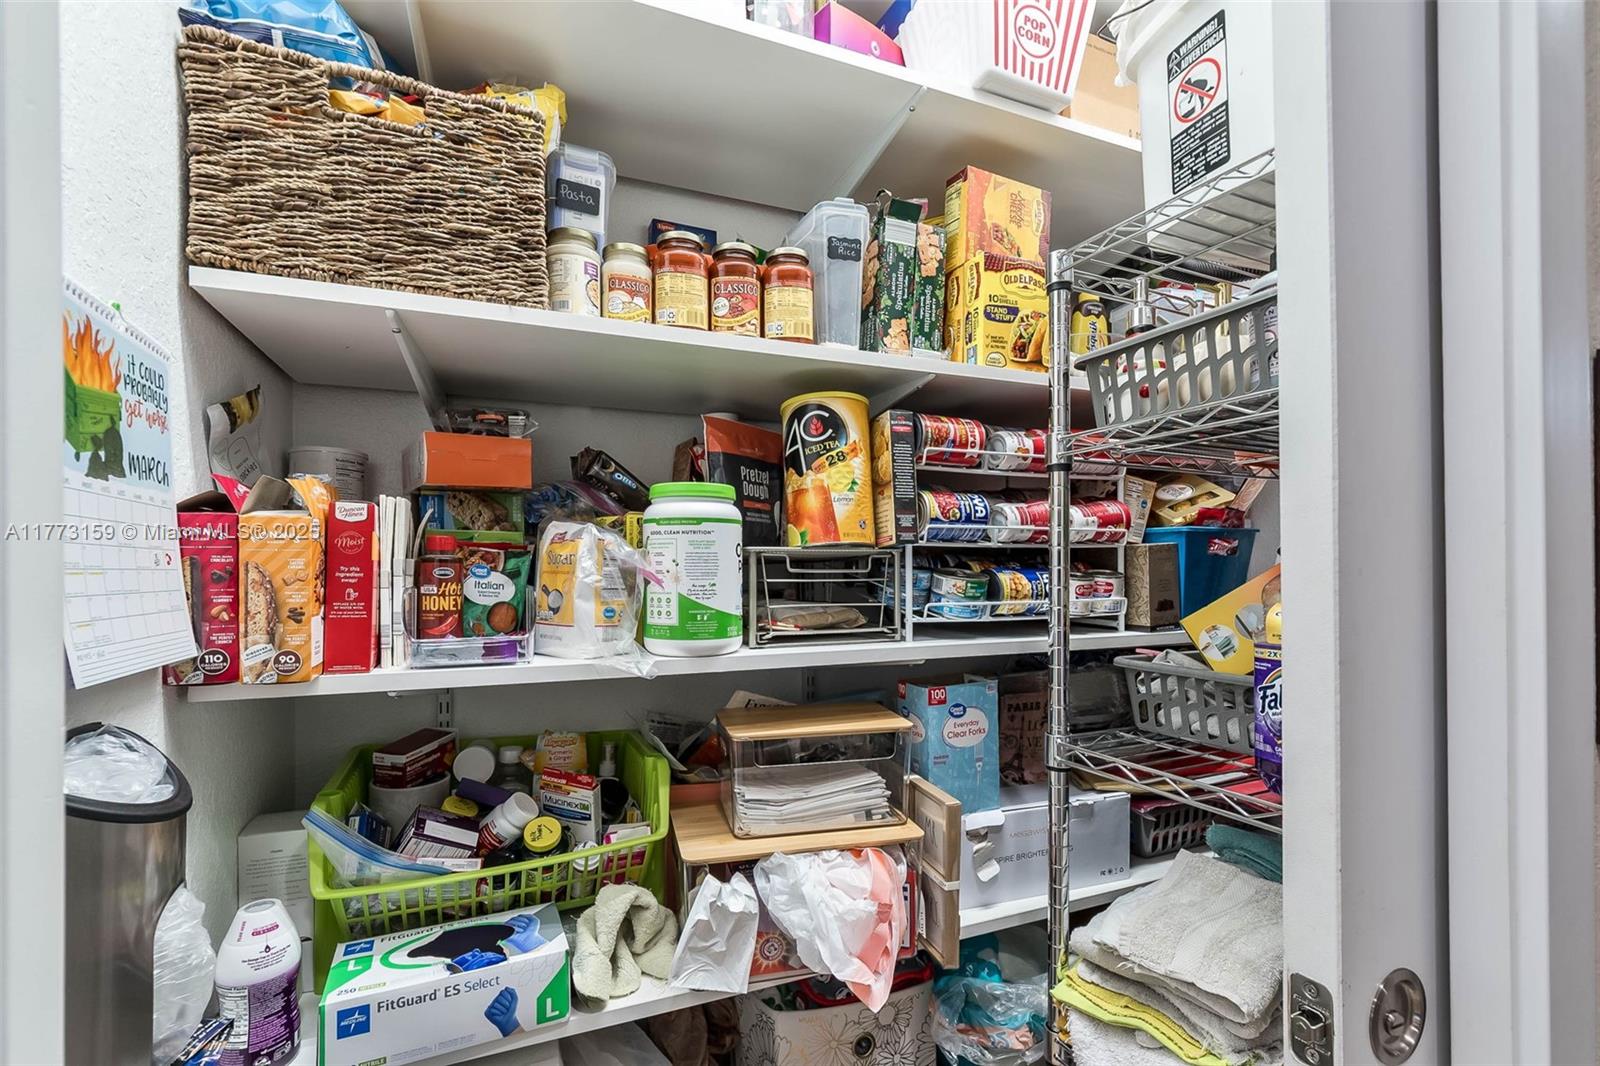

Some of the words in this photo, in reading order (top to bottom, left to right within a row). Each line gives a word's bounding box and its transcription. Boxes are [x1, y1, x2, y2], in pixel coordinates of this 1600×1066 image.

[1023, 14, 1047, 32] POP
[1017, 25, 1050, 48] CORN
[1180, 28, 1224, 71] ADVERTENCIA
[559, 183, 596, 206] Pasta
[830, 237, 861, 250] Jasmine
[837, 246, 857, 257] Rice
[608, 278, 650, 294] CLASSICO
[714, 282, 759, 297] CLASSICO
[895, 262, 905, 311] Spekulatius
[988, 293, 999, 303] 10
[924, 285, 933, 333] Spekulatius
[986, 306, 1008, 315] STAND
[127, 354, 136, 374] it
[138, 361, 165, 391] COULD
[125, 399, 144, 428] get
[805, 443, 825, 455] ICED
[824, 440, 841, 450] TEA
[826, 451, 847, 467] 28
[740, 466, 769, 484] Pretzel
[743, 482, 769, 500] Dough
[337, 506, 365, 514] Duncan
[334, 536, 365, 548] Moist
[439, 581, 462, 596] Hot
[474, 580, 505, 591] Italian
[421, 595, 462, 611] HONEY
[203, 653, 224, 663] 110
[278, 654, 296, 664] 90
[1267, 650, 1278, 659] 2X
[930, 689, 946, 700] 100
[1007, 702, 1041, 713] PARIS
[953, 719, 980, 730] Everyday
[946, 729, 967, 740] Clear
[968, 726, 986, 737] Forks
[346, 959, 363, 972] L
[336, 986, 357, 996] 250
[444, 983, 461, 998] ES
[463, 975, 501, 993] Select
[545, 997, 560, 1018] L
